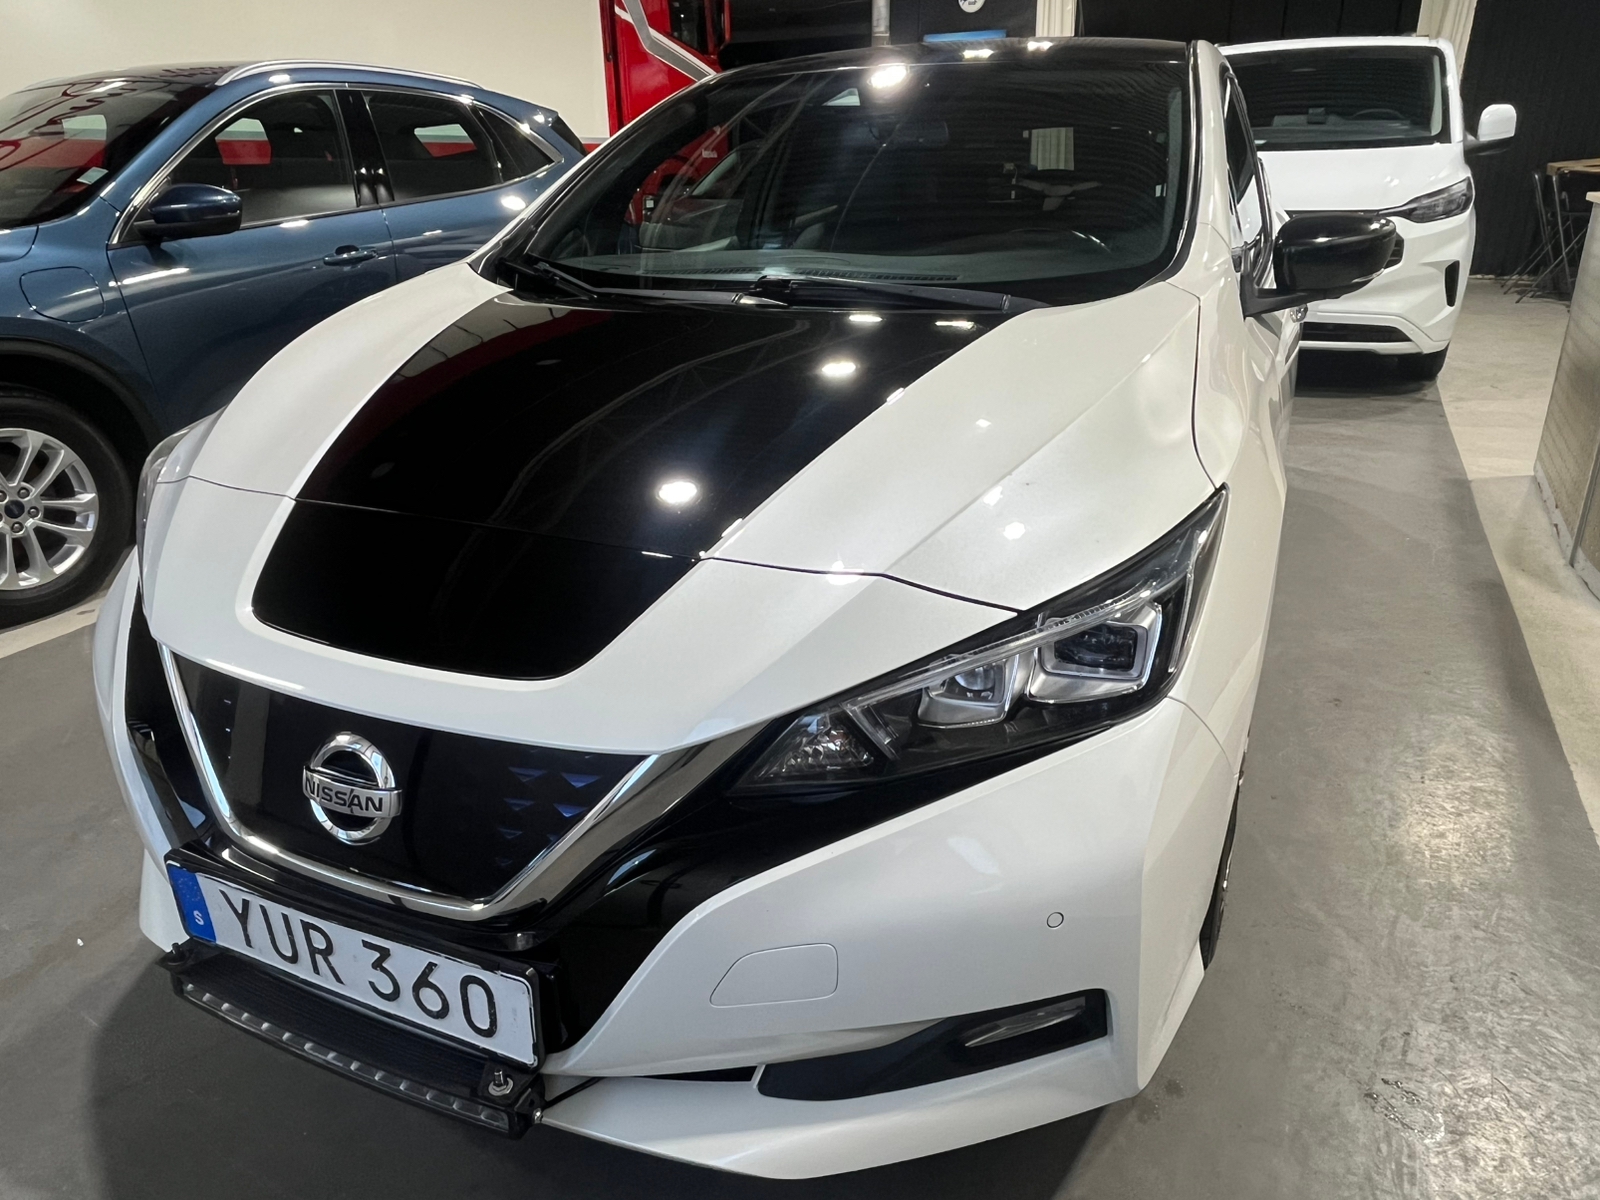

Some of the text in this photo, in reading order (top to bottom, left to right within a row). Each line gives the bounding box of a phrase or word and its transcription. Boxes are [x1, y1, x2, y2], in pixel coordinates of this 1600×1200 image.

[305, 779, 383, 813] NISSAN
[193, 910, 204, 925] S
[219, 889, 498, 1038] YUR 360
